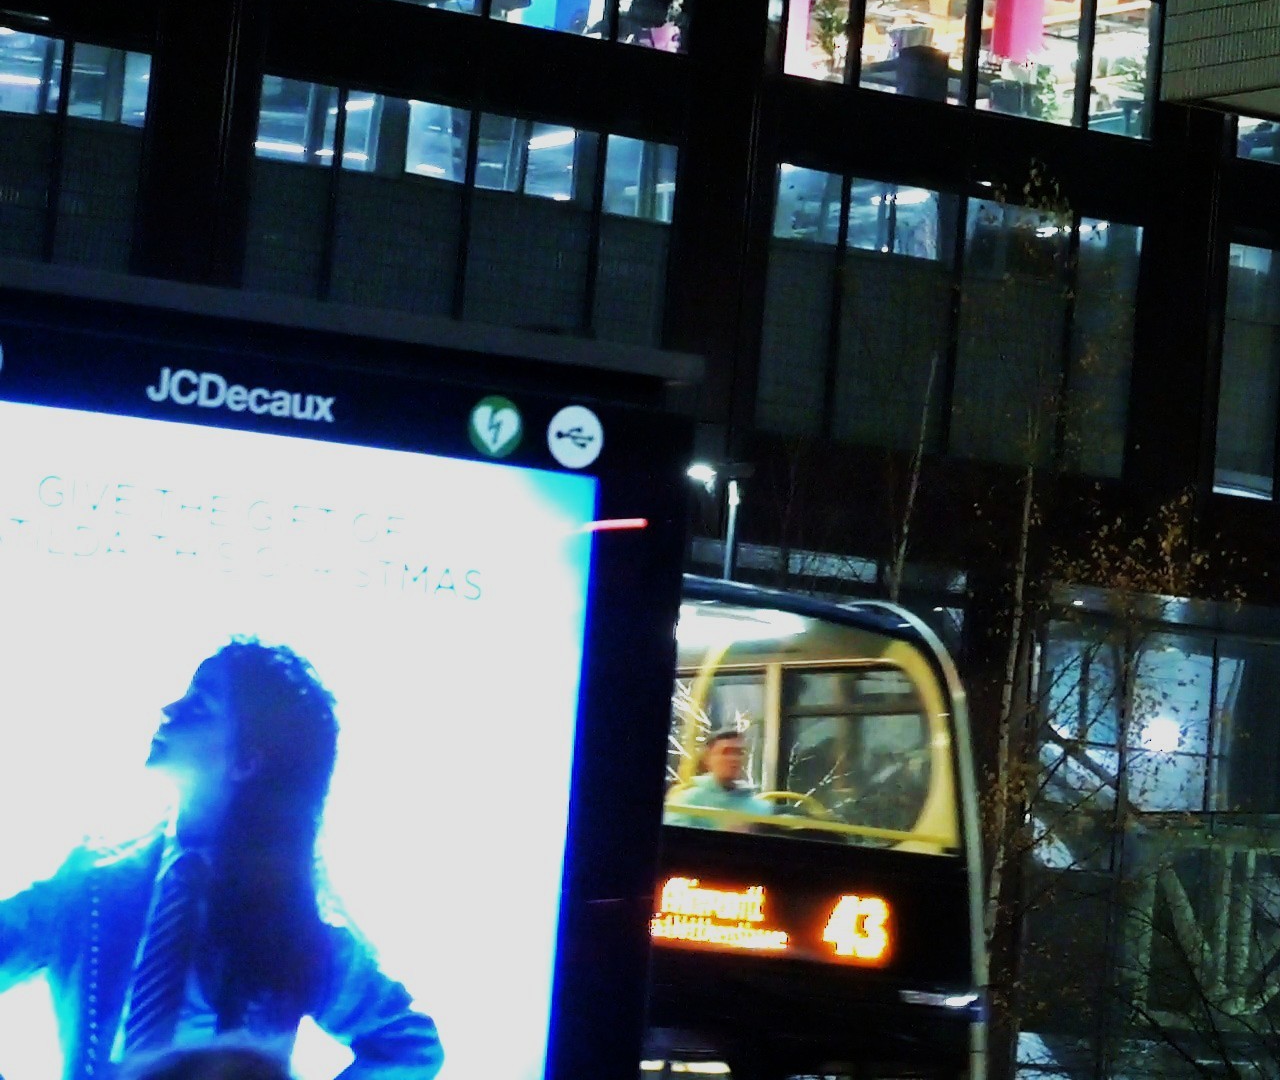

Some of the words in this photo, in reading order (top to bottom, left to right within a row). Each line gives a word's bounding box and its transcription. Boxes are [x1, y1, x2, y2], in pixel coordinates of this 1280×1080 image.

[146, 367, 335, 422] JCDecaux
[247, 499, 336, 533] GFT
[823, 894, 890, 959] 43
